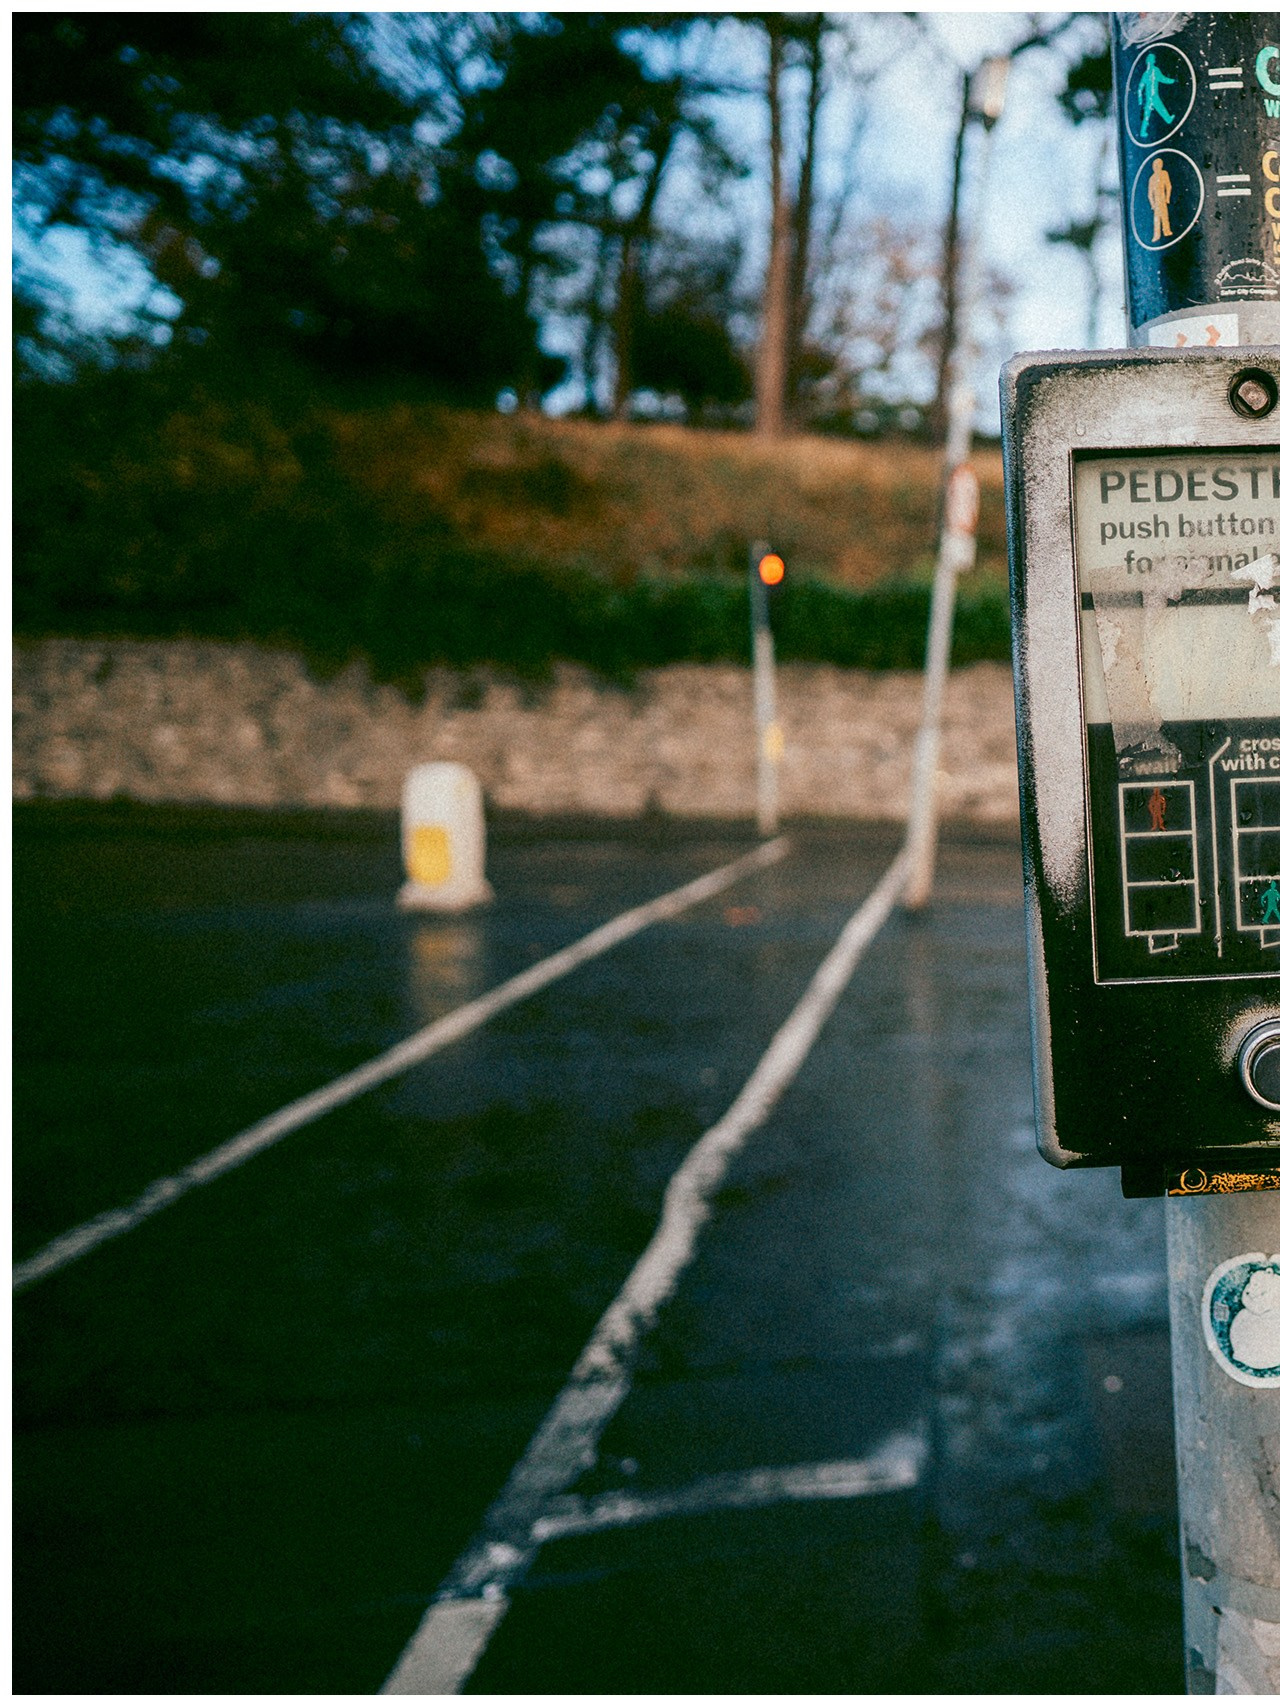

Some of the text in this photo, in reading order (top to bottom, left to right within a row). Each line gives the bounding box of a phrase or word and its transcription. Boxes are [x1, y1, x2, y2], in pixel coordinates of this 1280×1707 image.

[1100, 512, 1170, 545] push
[1178, 511, 1275, 539] button
[1124, 549, 1165, 575] fo
[1221, 748, 1265, 772] with
